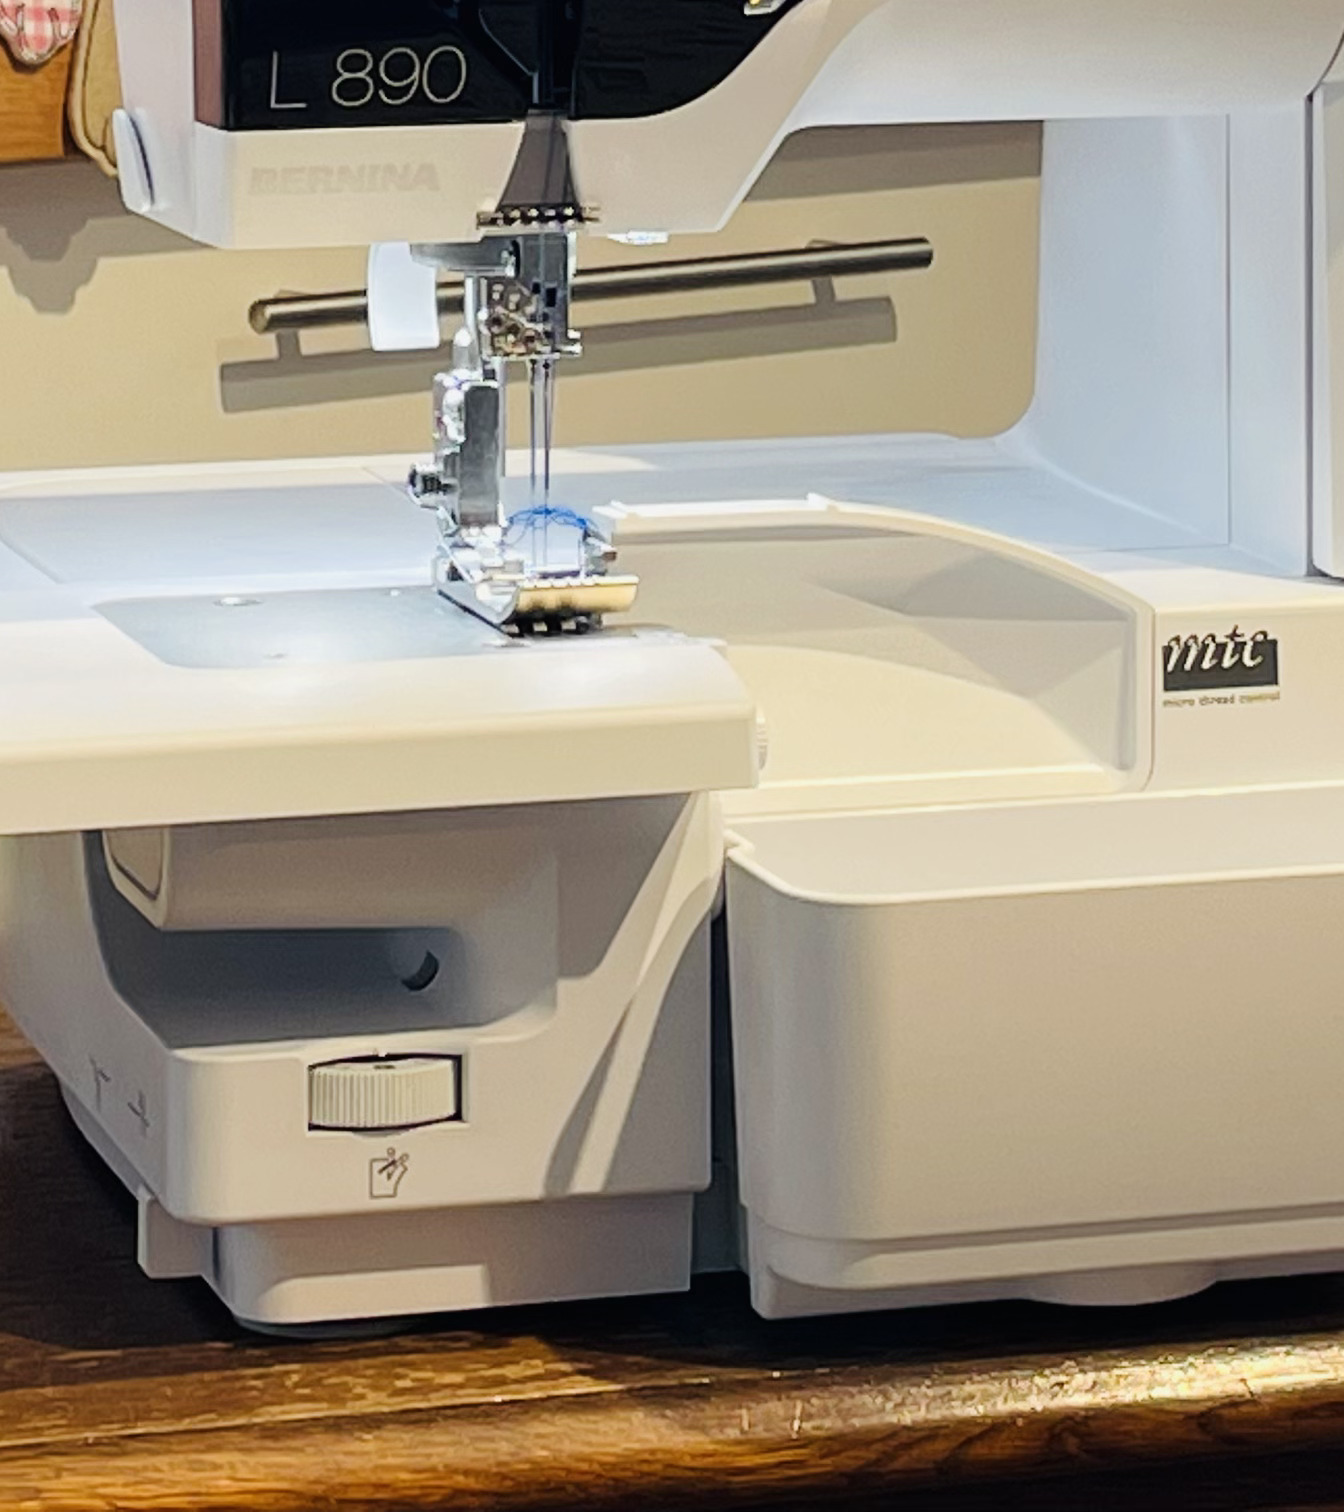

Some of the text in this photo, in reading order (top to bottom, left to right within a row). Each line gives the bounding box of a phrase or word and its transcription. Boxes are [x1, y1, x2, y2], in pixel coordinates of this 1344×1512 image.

[270, 45, 467, 109] L 890
[249, 162, 441, 196] BERNINA
[1166, 623, 1269, 673] mtc
[1198, 693, 1235, 706] thread
